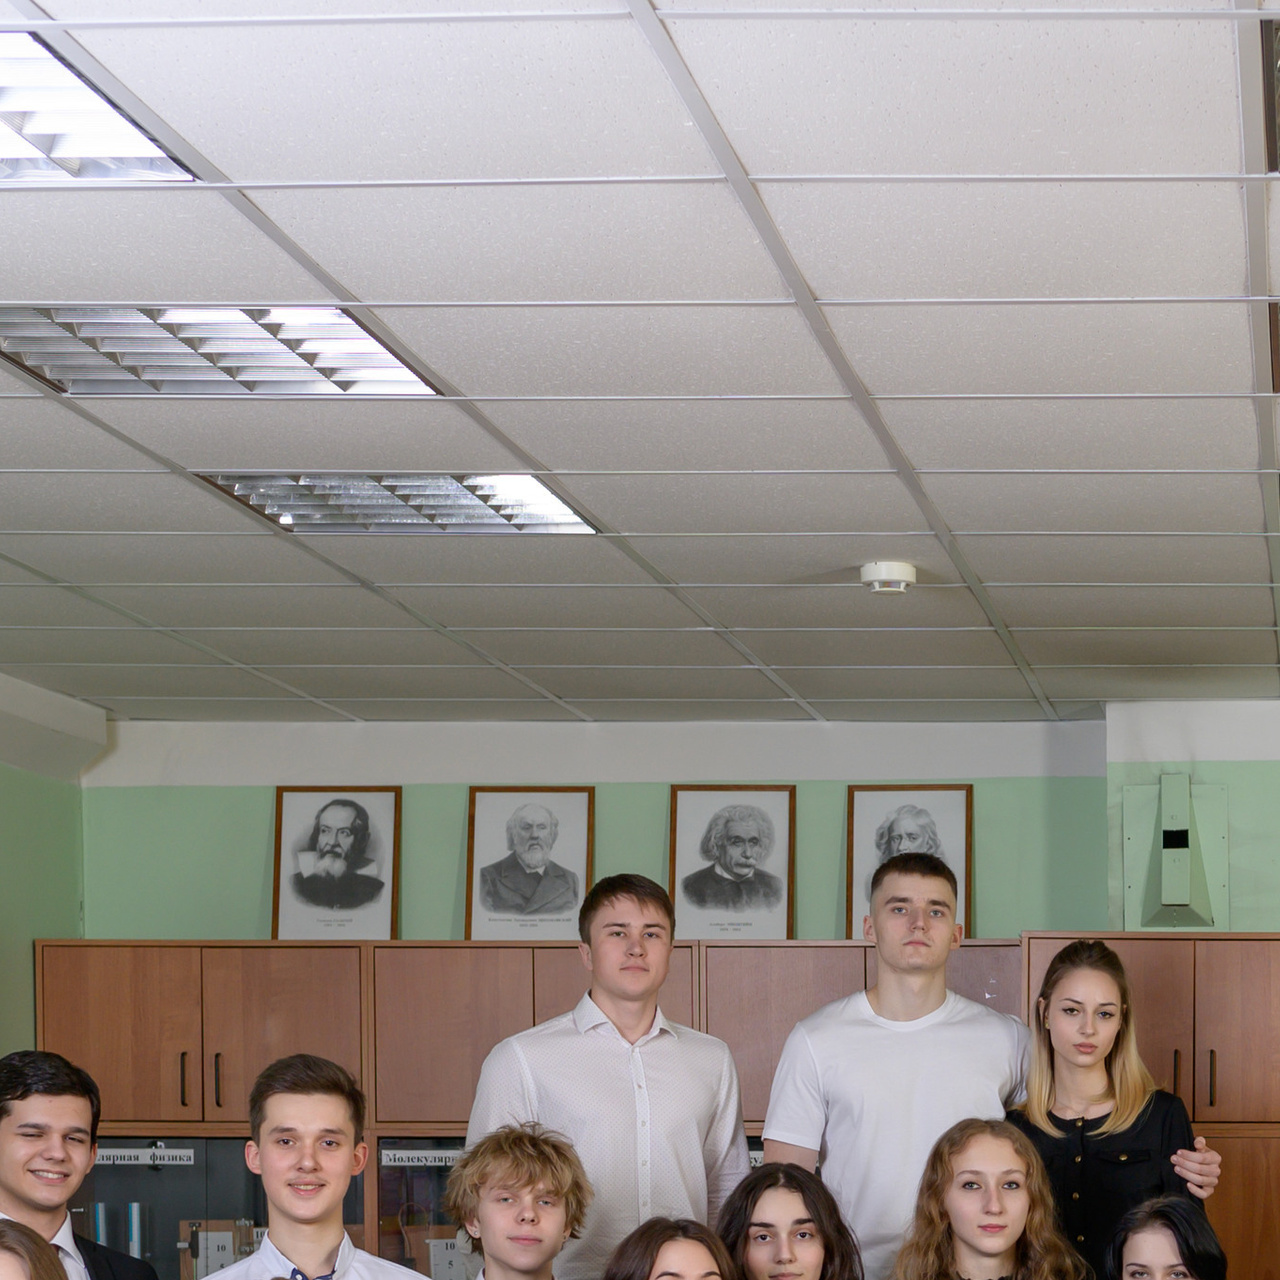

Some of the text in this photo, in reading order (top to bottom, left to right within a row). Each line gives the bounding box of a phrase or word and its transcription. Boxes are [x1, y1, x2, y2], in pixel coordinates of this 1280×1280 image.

[149, 1152, 192, 1165] физика
[216, 1244, 227, 1252] 10
[445, 1242, 455, 1251] 10
[448, 1260, 454, 1269] 5
